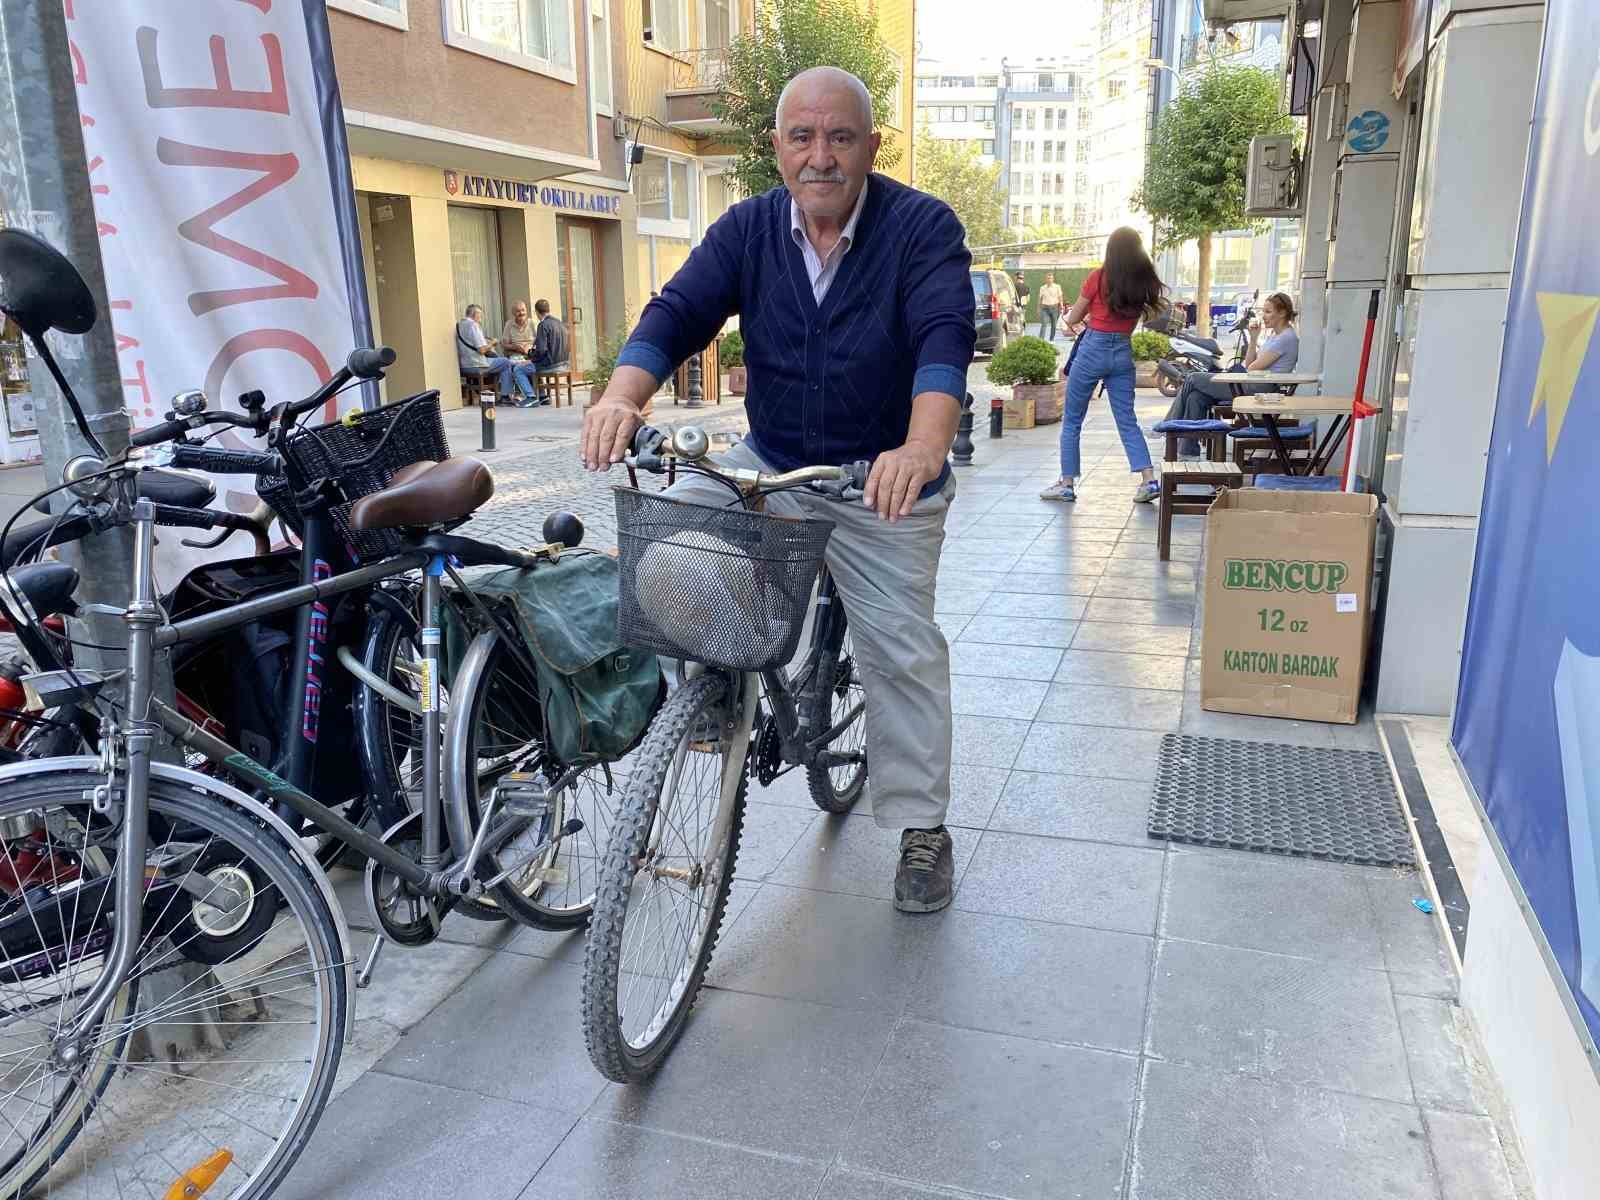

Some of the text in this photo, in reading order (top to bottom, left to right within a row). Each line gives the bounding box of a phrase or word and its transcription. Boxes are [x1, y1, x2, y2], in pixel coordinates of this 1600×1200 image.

[463, 175, 613, 213] ATAYURT OKULLARI
[1223, 558, 1348, 593] BENCUP
[1258, 608, 1285, 632] 12
[1223, 649, 1340, 678] KARTON BARDAK
